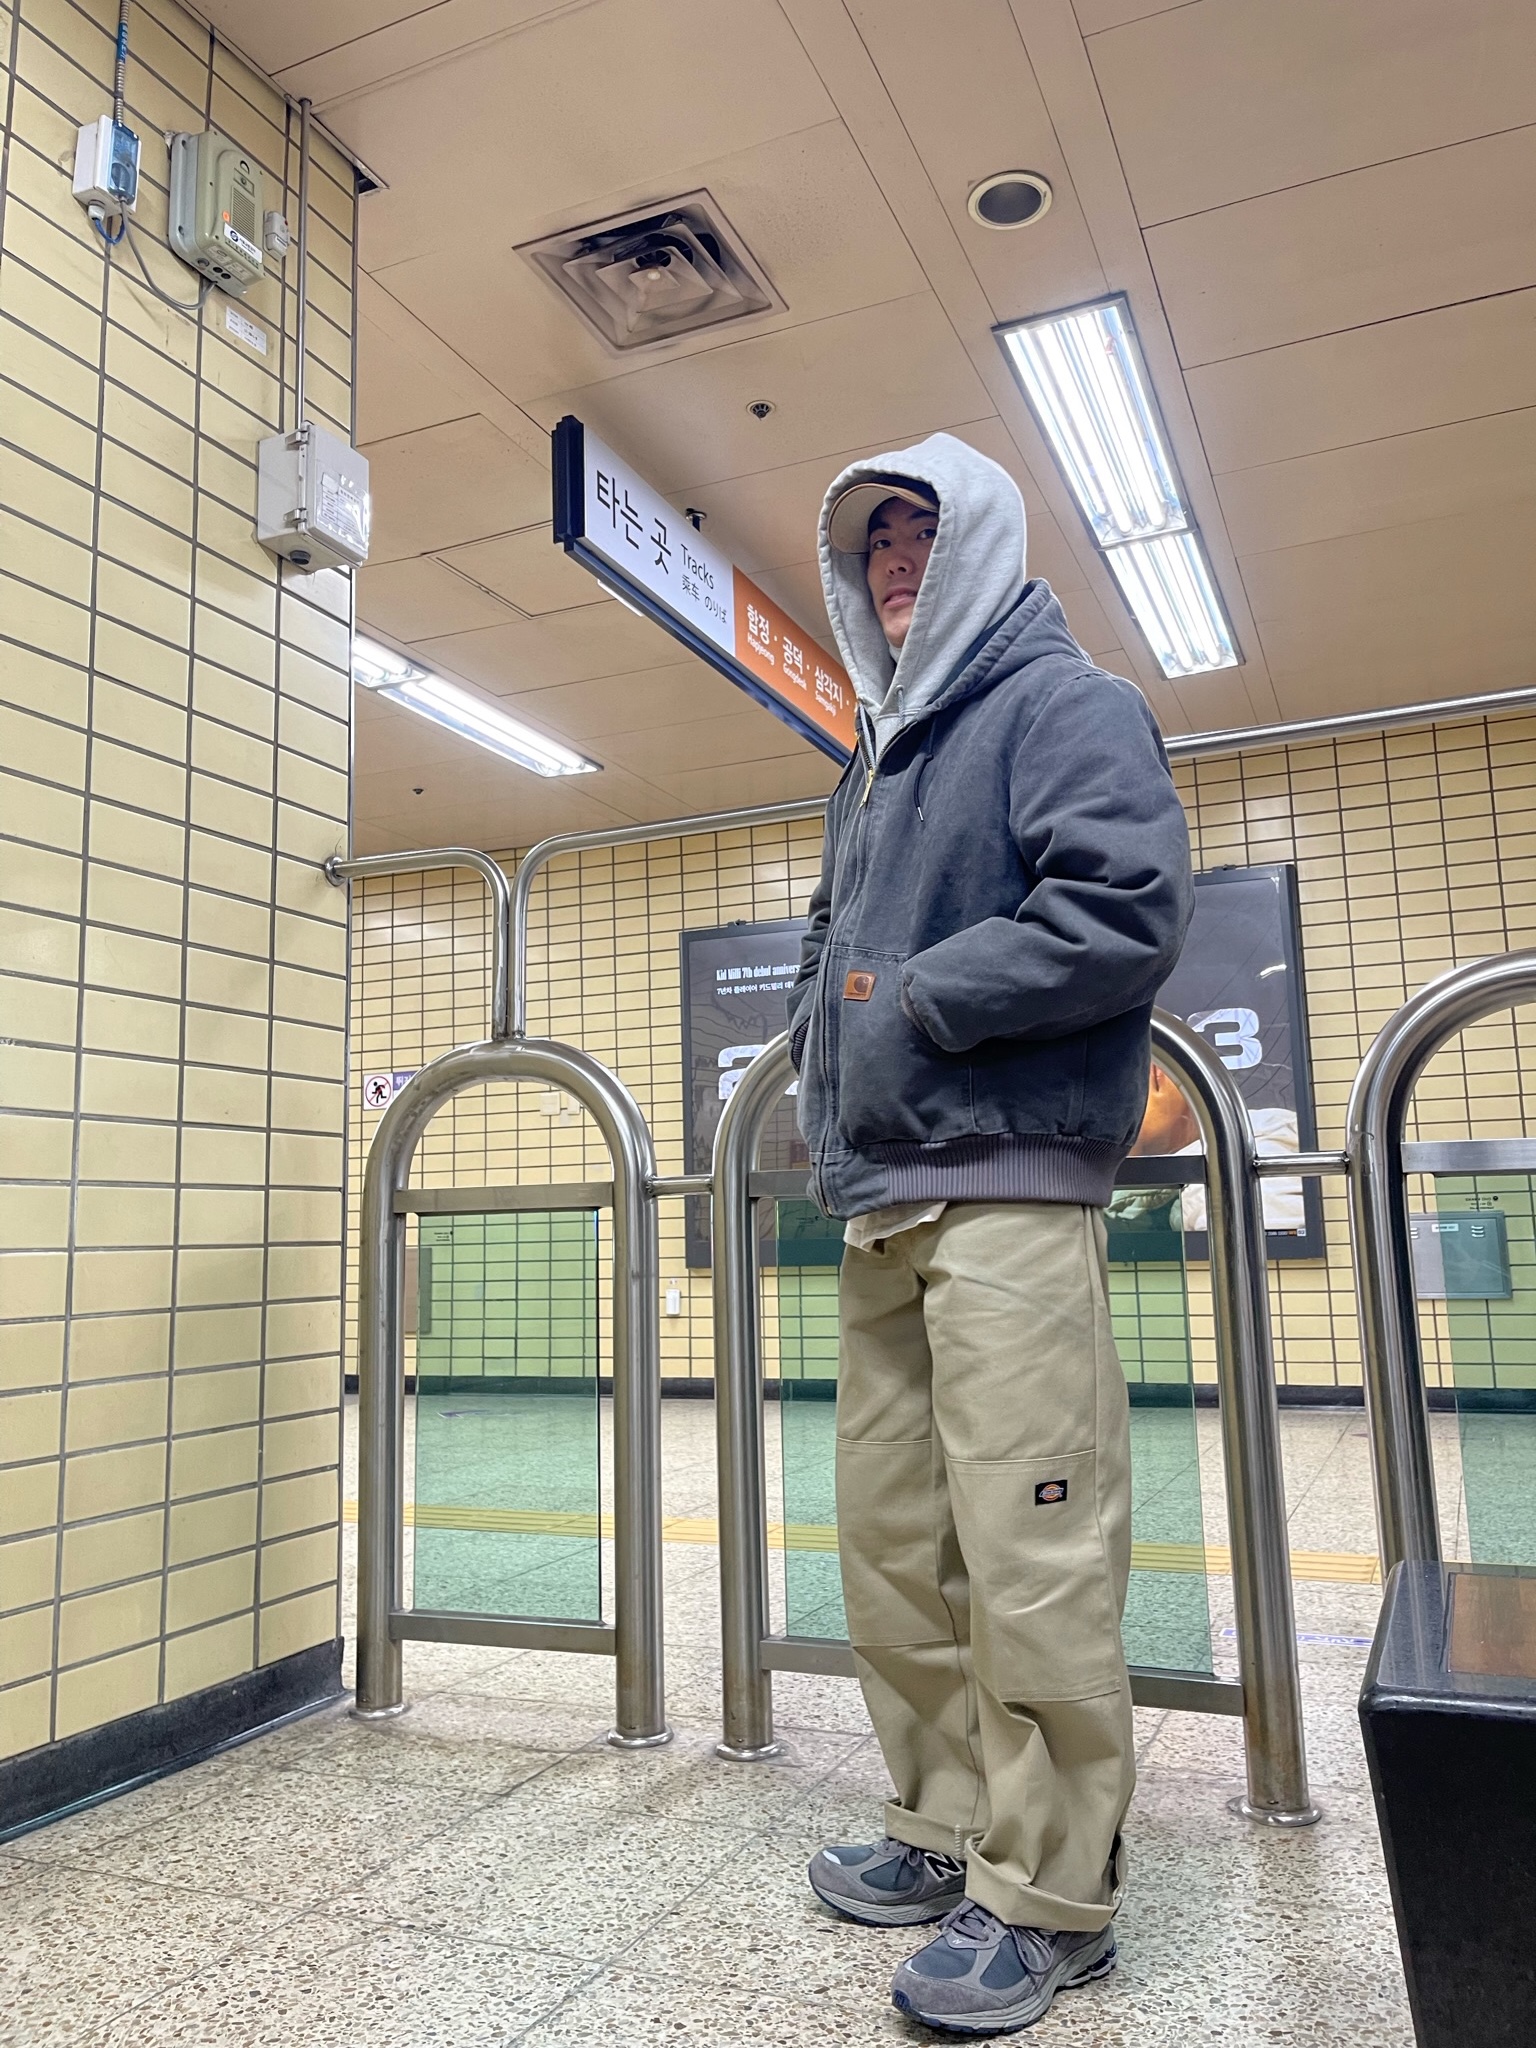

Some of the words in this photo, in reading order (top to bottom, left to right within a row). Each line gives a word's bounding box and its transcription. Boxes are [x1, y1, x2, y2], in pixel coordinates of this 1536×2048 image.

[596, 469, 643, 550] 타는
[650, 517, 672, 575] 곳
[681, 543, 714, 590] Tracks
[705, 596, 727, 624] のりば
[747, 604, 770, 645] 합정
[783, 636, 803, 675] 공덕
[815, 666, 843, 710] 삼각지
[716, 969, 727, 981] Kid
[742, 967, 753, 979] 7th
[754, 965, 771, 978] debut
[772, 963, 801, 976] annivers
